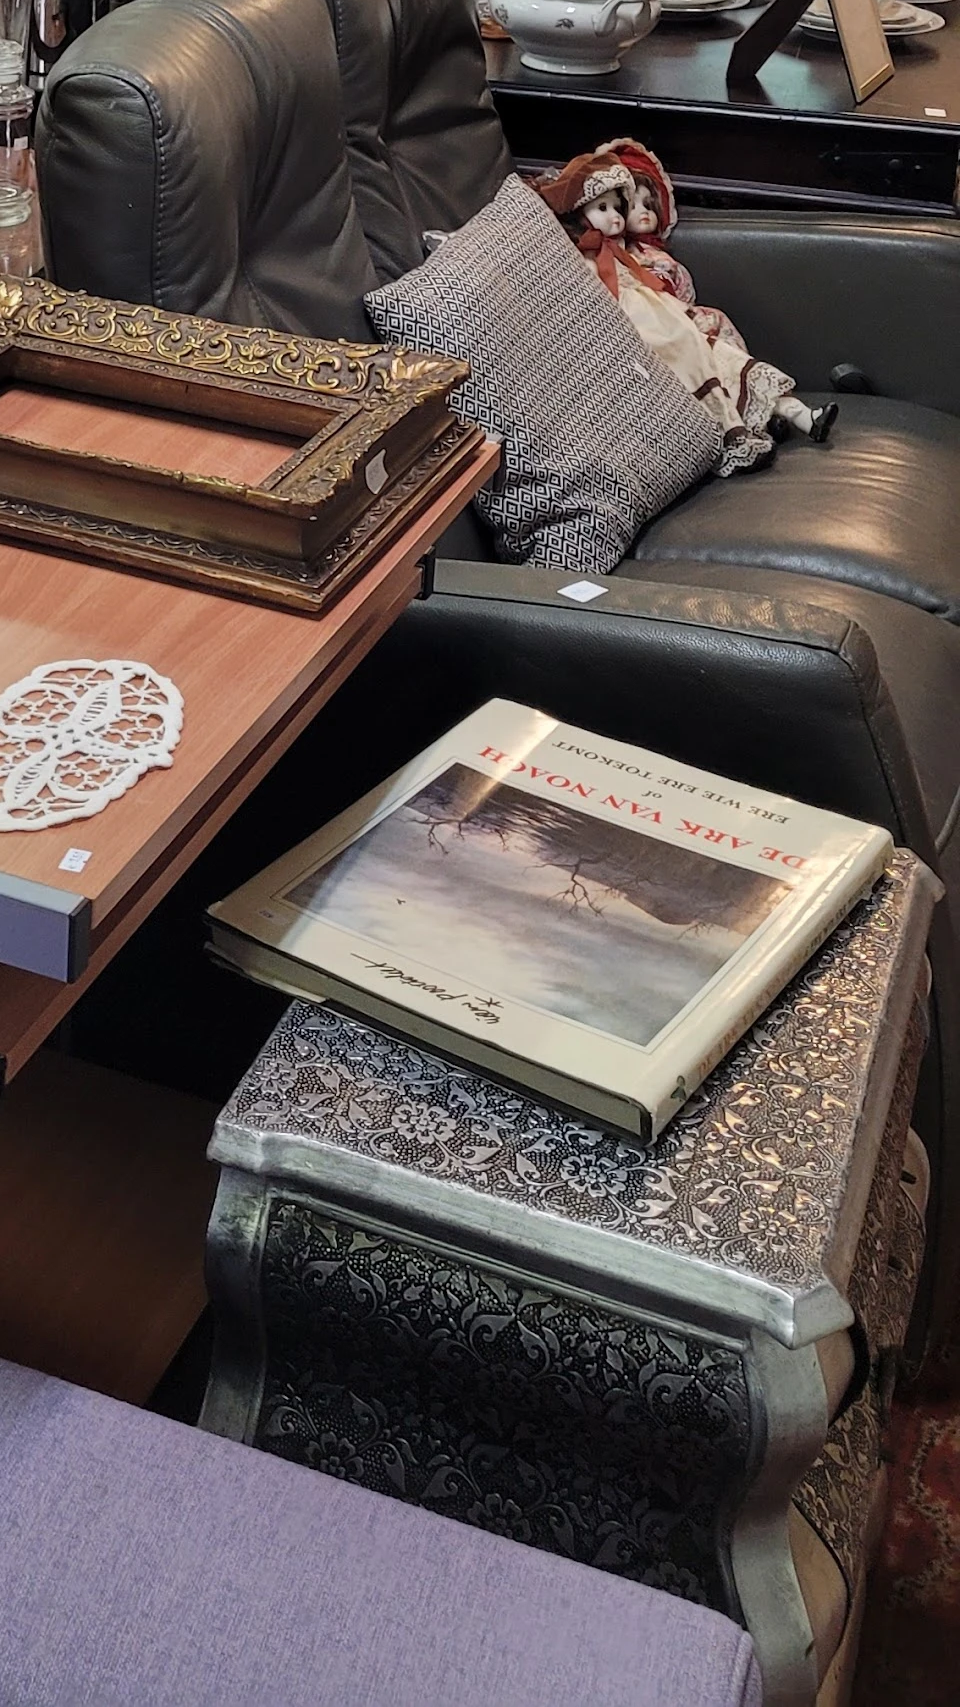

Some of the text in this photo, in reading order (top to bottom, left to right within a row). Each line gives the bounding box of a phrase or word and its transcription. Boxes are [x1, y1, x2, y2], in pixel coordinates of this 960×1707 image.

[478, 745, 808, 871] DE ARK VAN NOACH
[552, 740, 791, 824] ERE WIE ERE TOEKOMT
[641, 789, 663, 800] of
